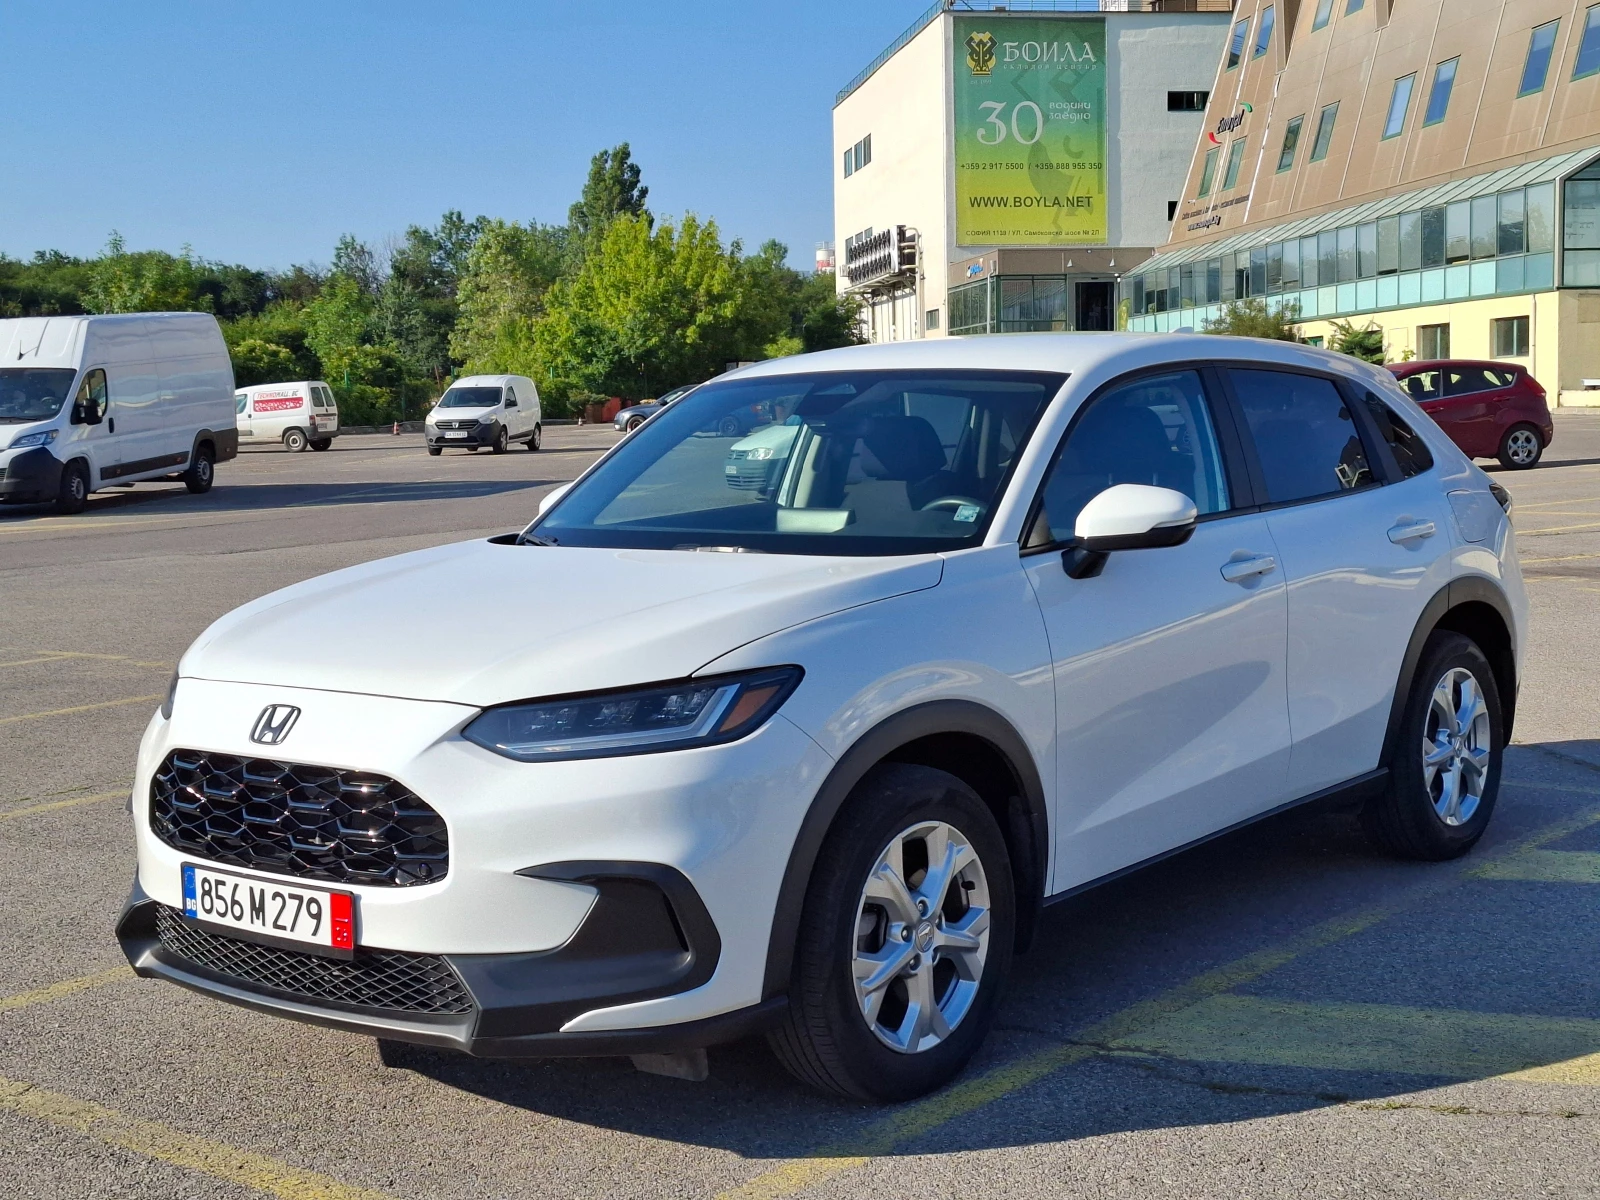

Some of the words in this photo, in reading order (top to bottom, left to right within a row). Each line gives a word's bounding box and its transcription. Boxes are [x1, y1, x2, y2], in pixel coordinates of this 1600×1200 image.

[1003, 41, 1097, 62] БОИЛА
[977, 101, 1044, 145] 30
[1088, 162, 1102, 170] 350
[969, 196, 1093, 208] WWW.BOYLA.NET
[186, 898, 197, 911] BG
